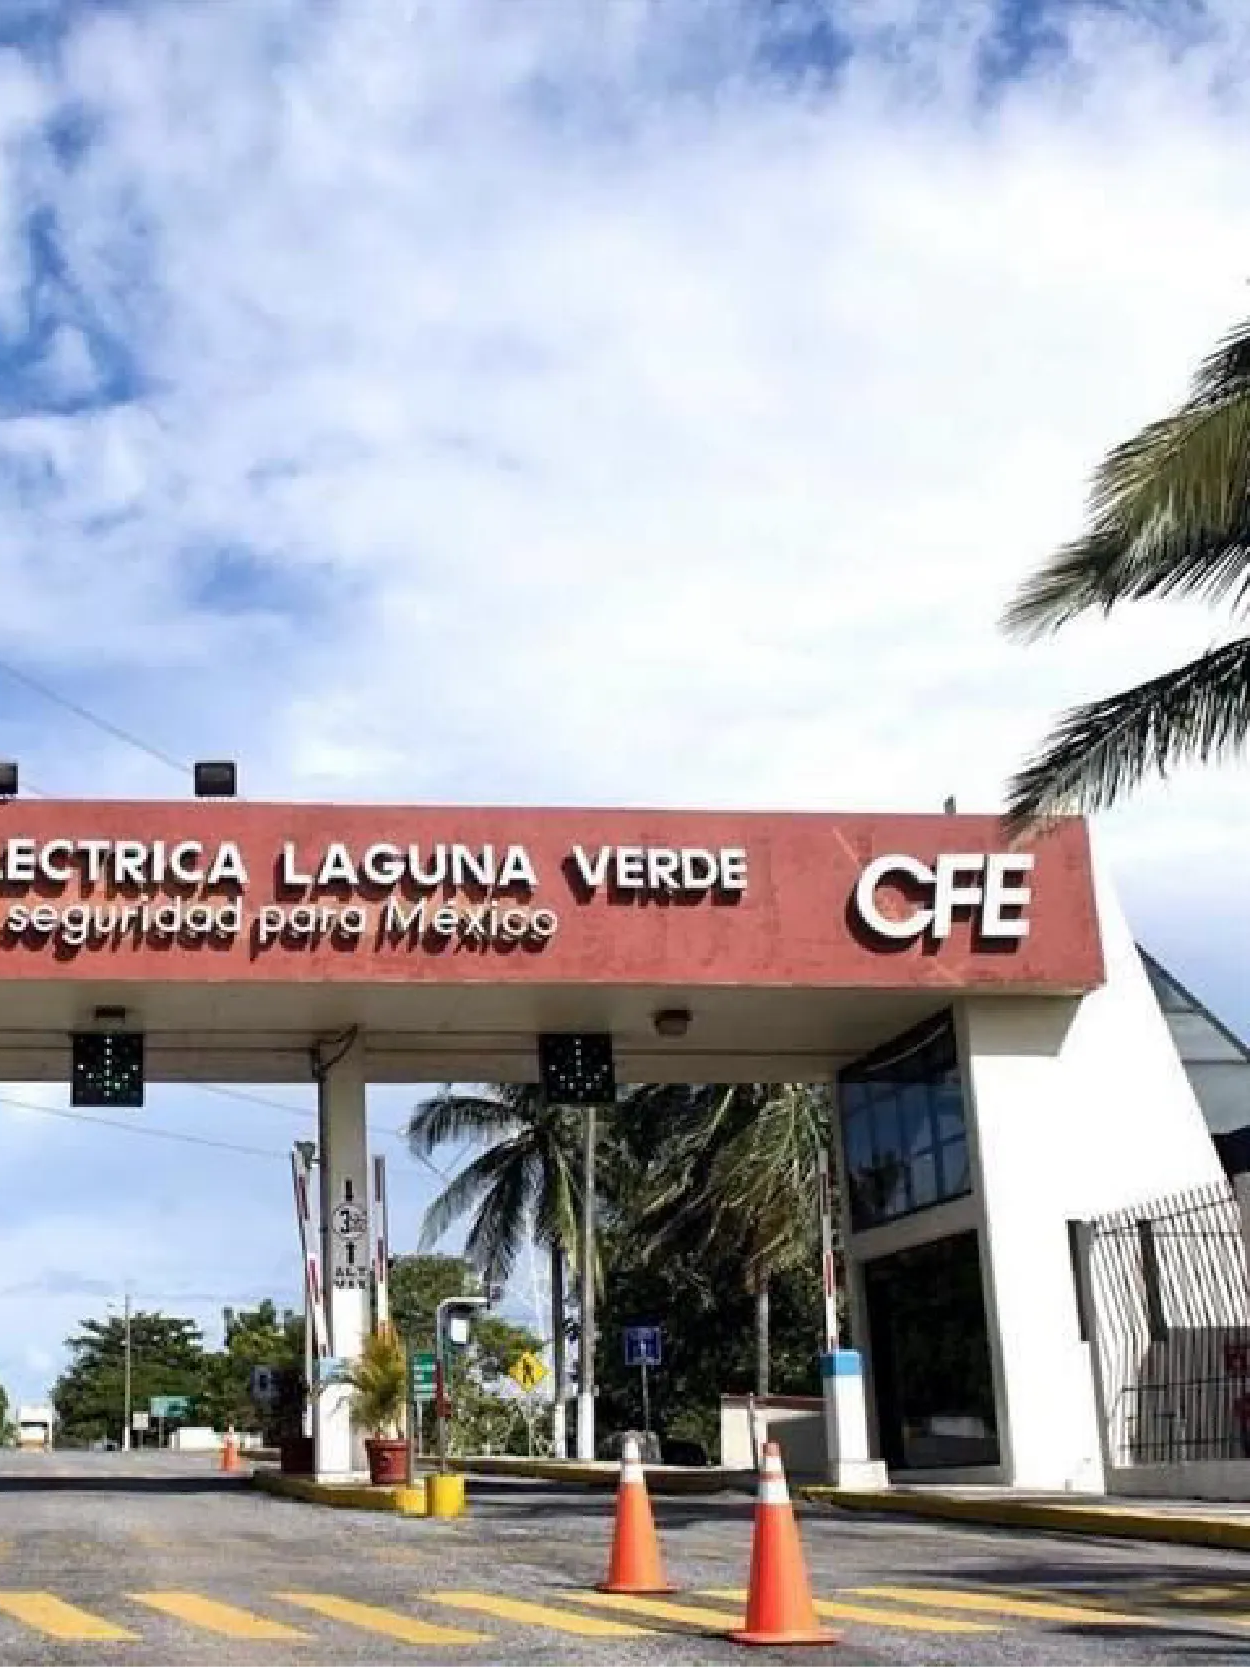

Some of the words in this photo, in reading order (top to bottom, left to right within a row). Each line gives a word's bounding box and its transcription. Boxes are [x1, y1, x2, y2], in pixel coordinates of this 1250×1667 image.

[283, 843, 539, 887] LAGUNA
[572, 846, 749, 891] VERDE
[7, 895, 243, 944] seguridad
[258, 900, 368, 942] para
[385, 896, 560, 940] México
[856, 853, 1036, 939] CFE
